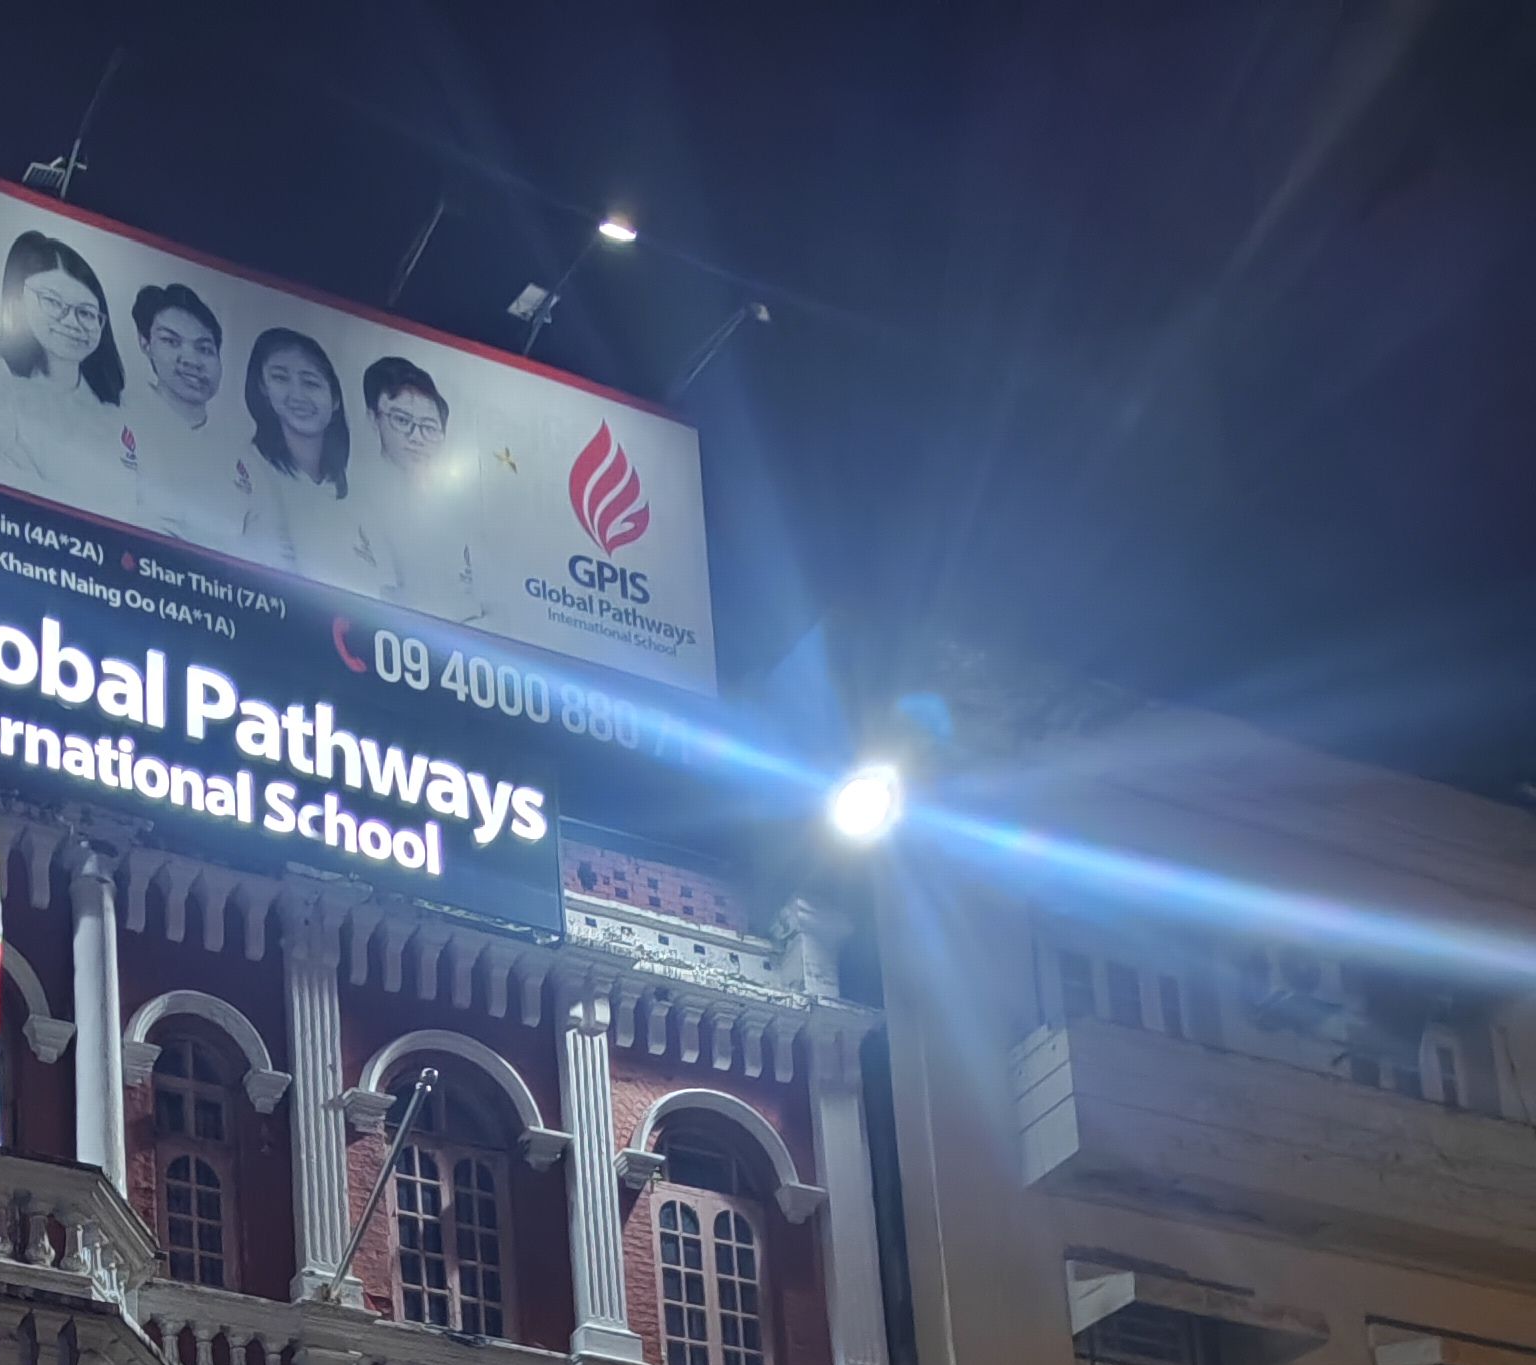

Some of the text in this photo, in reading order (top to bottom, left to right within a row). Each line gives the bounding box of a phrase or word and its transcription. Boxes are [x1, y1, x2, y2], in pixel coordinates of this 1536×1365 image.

[61, 567, 120, 609] Naing
[125, 587, 155, 615] Oo
[139, 557, 185, 591] Shar
[188, 574, 233, 604] Thiri
[568, 555, 651, 605] GPIS
[525, 577, 697, 646] Global Pathways
[547, 606, 632, 645] International
[375, 629, 430, 691] 09
[441, 650, 551, 724] 4000
[185, 662, 548, 846] Pathways
[263, 781, 443, 876] School
